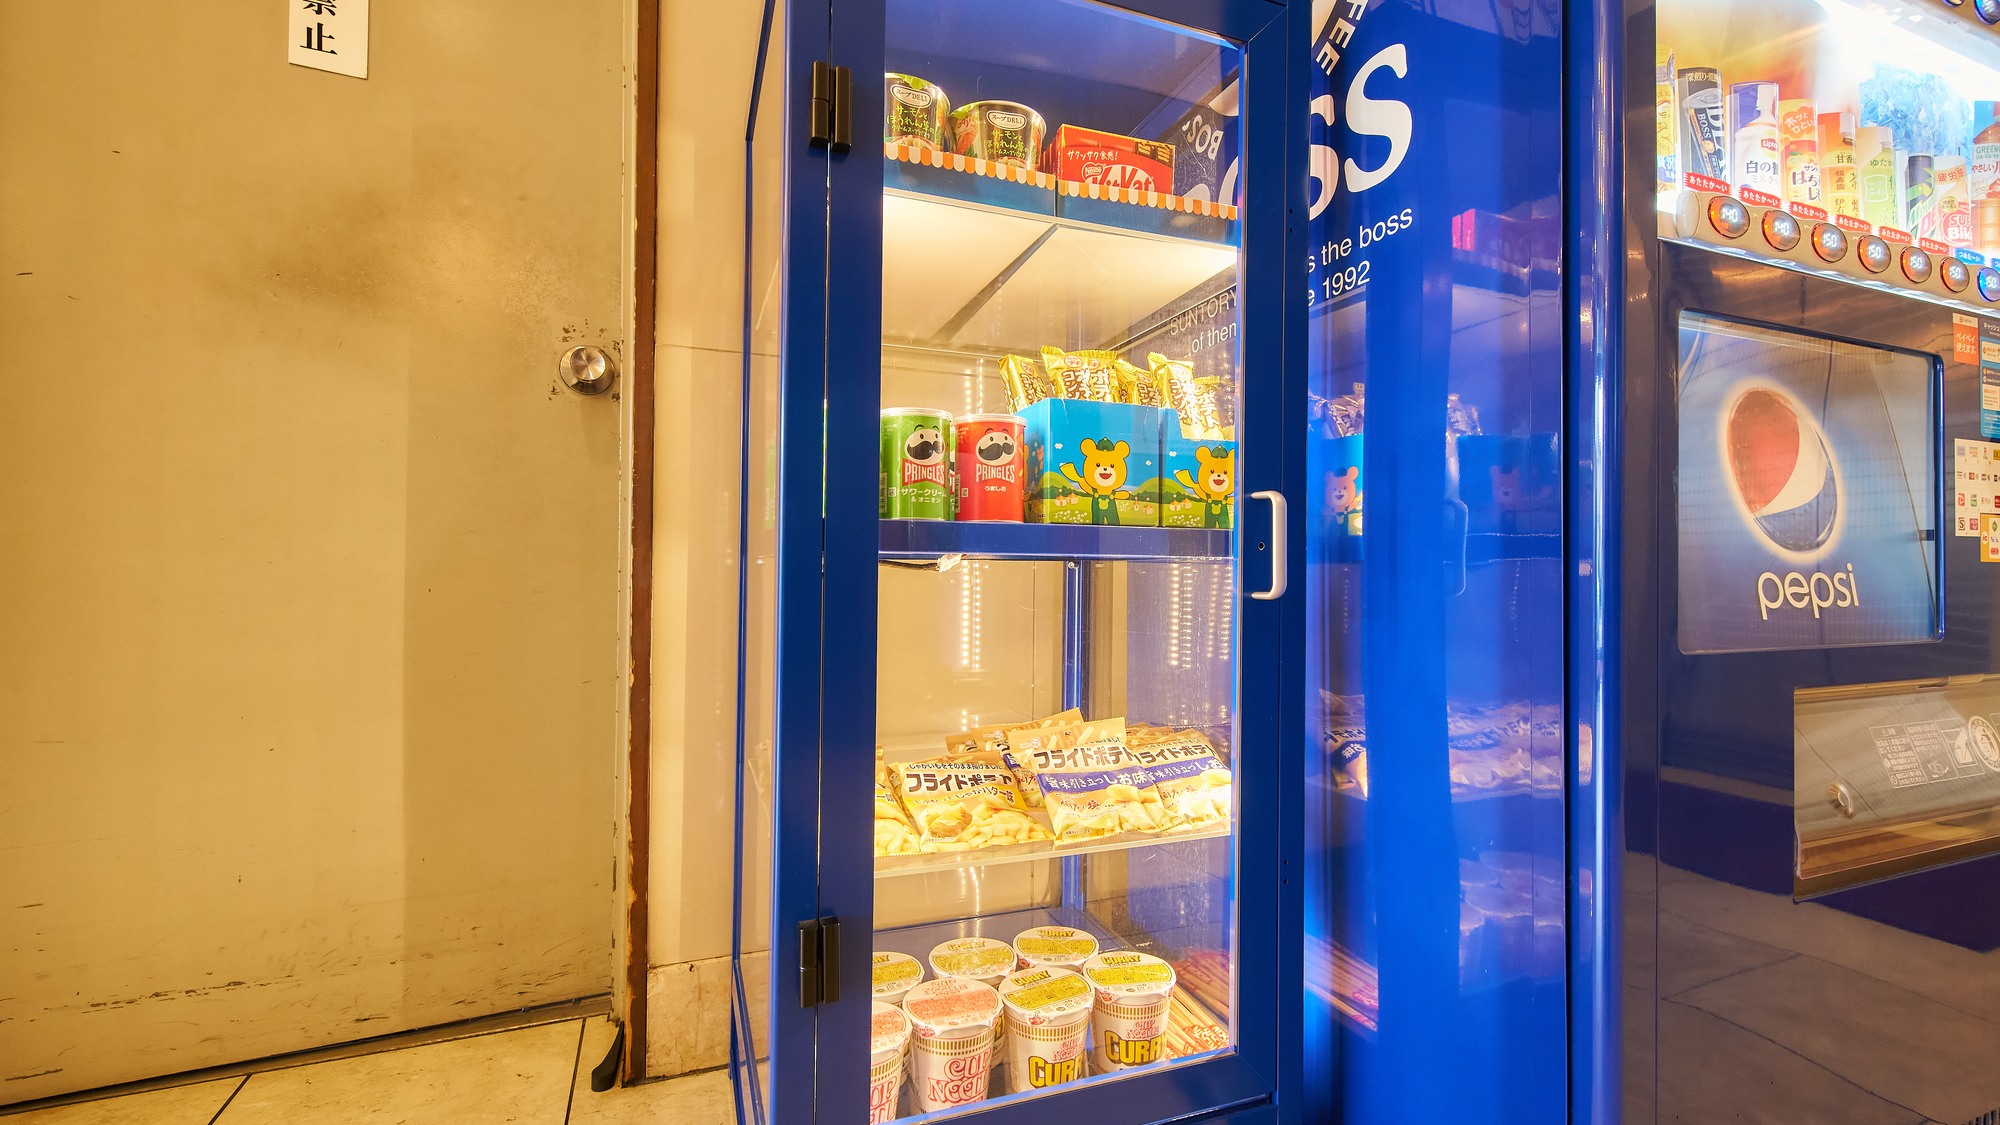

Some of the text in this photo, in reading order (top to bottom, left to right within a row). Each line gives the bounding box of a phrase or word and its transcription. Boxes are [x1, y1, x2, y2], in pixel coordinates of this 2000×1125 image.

[1697, 113, 1712, 139] BOSS
[1722, 207, 1738, 223] 140
[1321, 236, 1352, 266] the
[1359, 207, 1413, 249] boss
[1774, 221, 1790, 236] 140
[1823, 233, 1837, 248] 150
[1867, 245, 1882, 259] 150
[1910, 256, 1923, 269] 150
[1322, 260, 1370, 299] 1992
[904, 462, 945, 484] PRINGLES
[976, 464, 1015, 483] PRINGLES
[901, 488, 947, 498] サワークリーム
[1758, 562, 1859, 620] pepsi
[1036, 929, 1075, 938] CURRY
[1100, 955, 1141, 965] CURRY
[1010, 970, 1051, 986] CURRY
[1104, 1029, 1167, 1066] CURR
[944, 1048, 992, 1081] CUP
